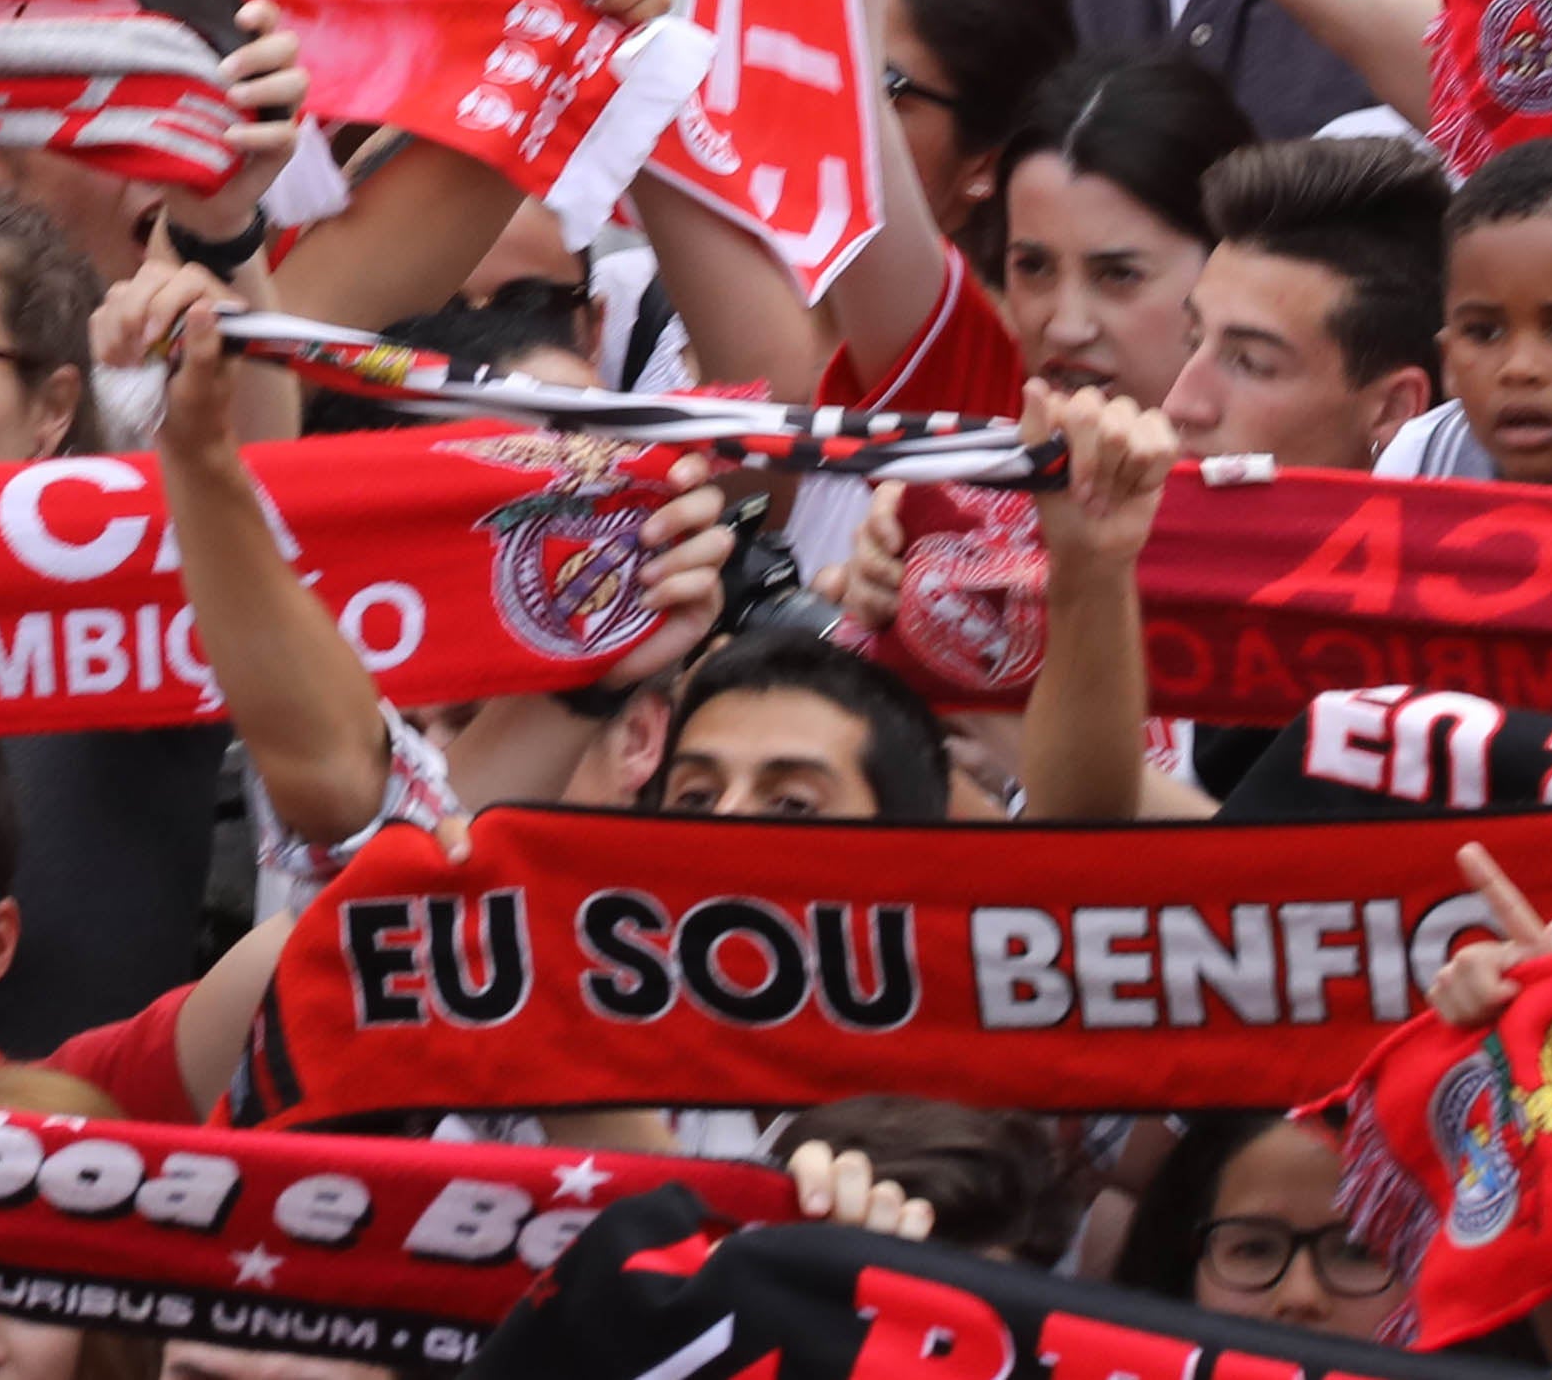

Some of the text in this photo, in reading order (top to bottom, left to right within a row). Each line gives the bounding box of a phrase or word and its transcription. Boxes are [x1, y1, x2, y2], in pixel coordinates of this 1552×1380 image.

[339, 883, 537, 1031] EU
[573, 885, 924, 1035] SOU
[271, 1173, 376, 1250] e
[209, 1295, 380, 1354] UNUM
